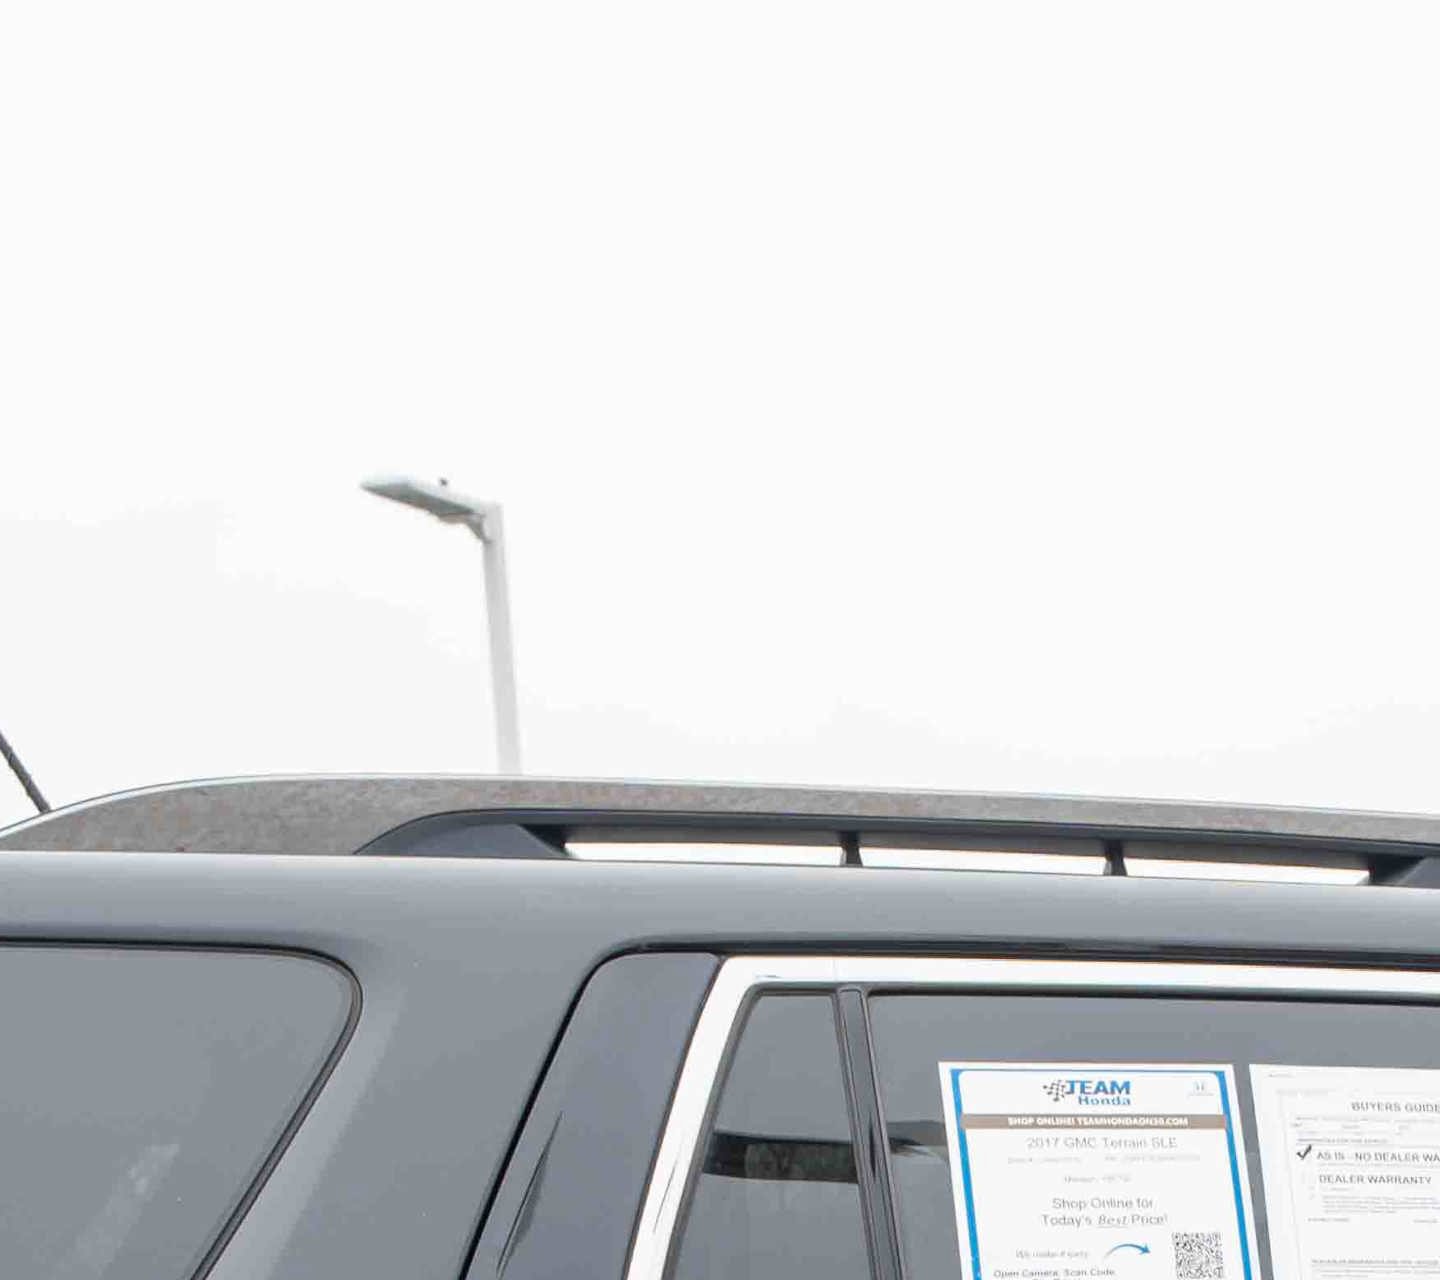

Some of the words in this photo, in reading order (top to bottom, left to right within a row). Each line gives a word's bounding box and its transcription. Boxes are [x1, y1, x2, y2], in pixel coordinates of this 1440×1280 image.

[1065, 1079, 1131, 1096] TEAM
[1077, 1095, 1132, 1106] Honda
[1351, 1101, 1402, 1112] BUYERS
[1008, 1117, 1035, 1126] SHOP
[1026, 1136, 1061, 1149] 2017
[1064, 1136, 1097, 1149] GMC
[1101, 1136, 1148, 1149] Terrain
[1151, 1136, 1178, 1149] SLE
[1316, 1152, 1333, 1161] AS
[1334, 1152, 1346, 1161] IS
[1355, 1152, 1372, 1162] NO
[1374, 1152, 1420, 1162] DEALER
[1318, 1175, 1365, 1184] DEALER
[1367, 1175, 1432, 1185] WARRANTY
[1052, 1197, 1087, 1211] Shop
[1090, 1197, 1133, 1209] Online
[1136, 1197, 1154, 1209] for
[1041, 1214, 1092, 1228] Today's
[1097, 1214, 1128, 1226] Best
[1130, 1213, 1168, 1225] Price!
[993, 1269, 1020, 1279] Open
